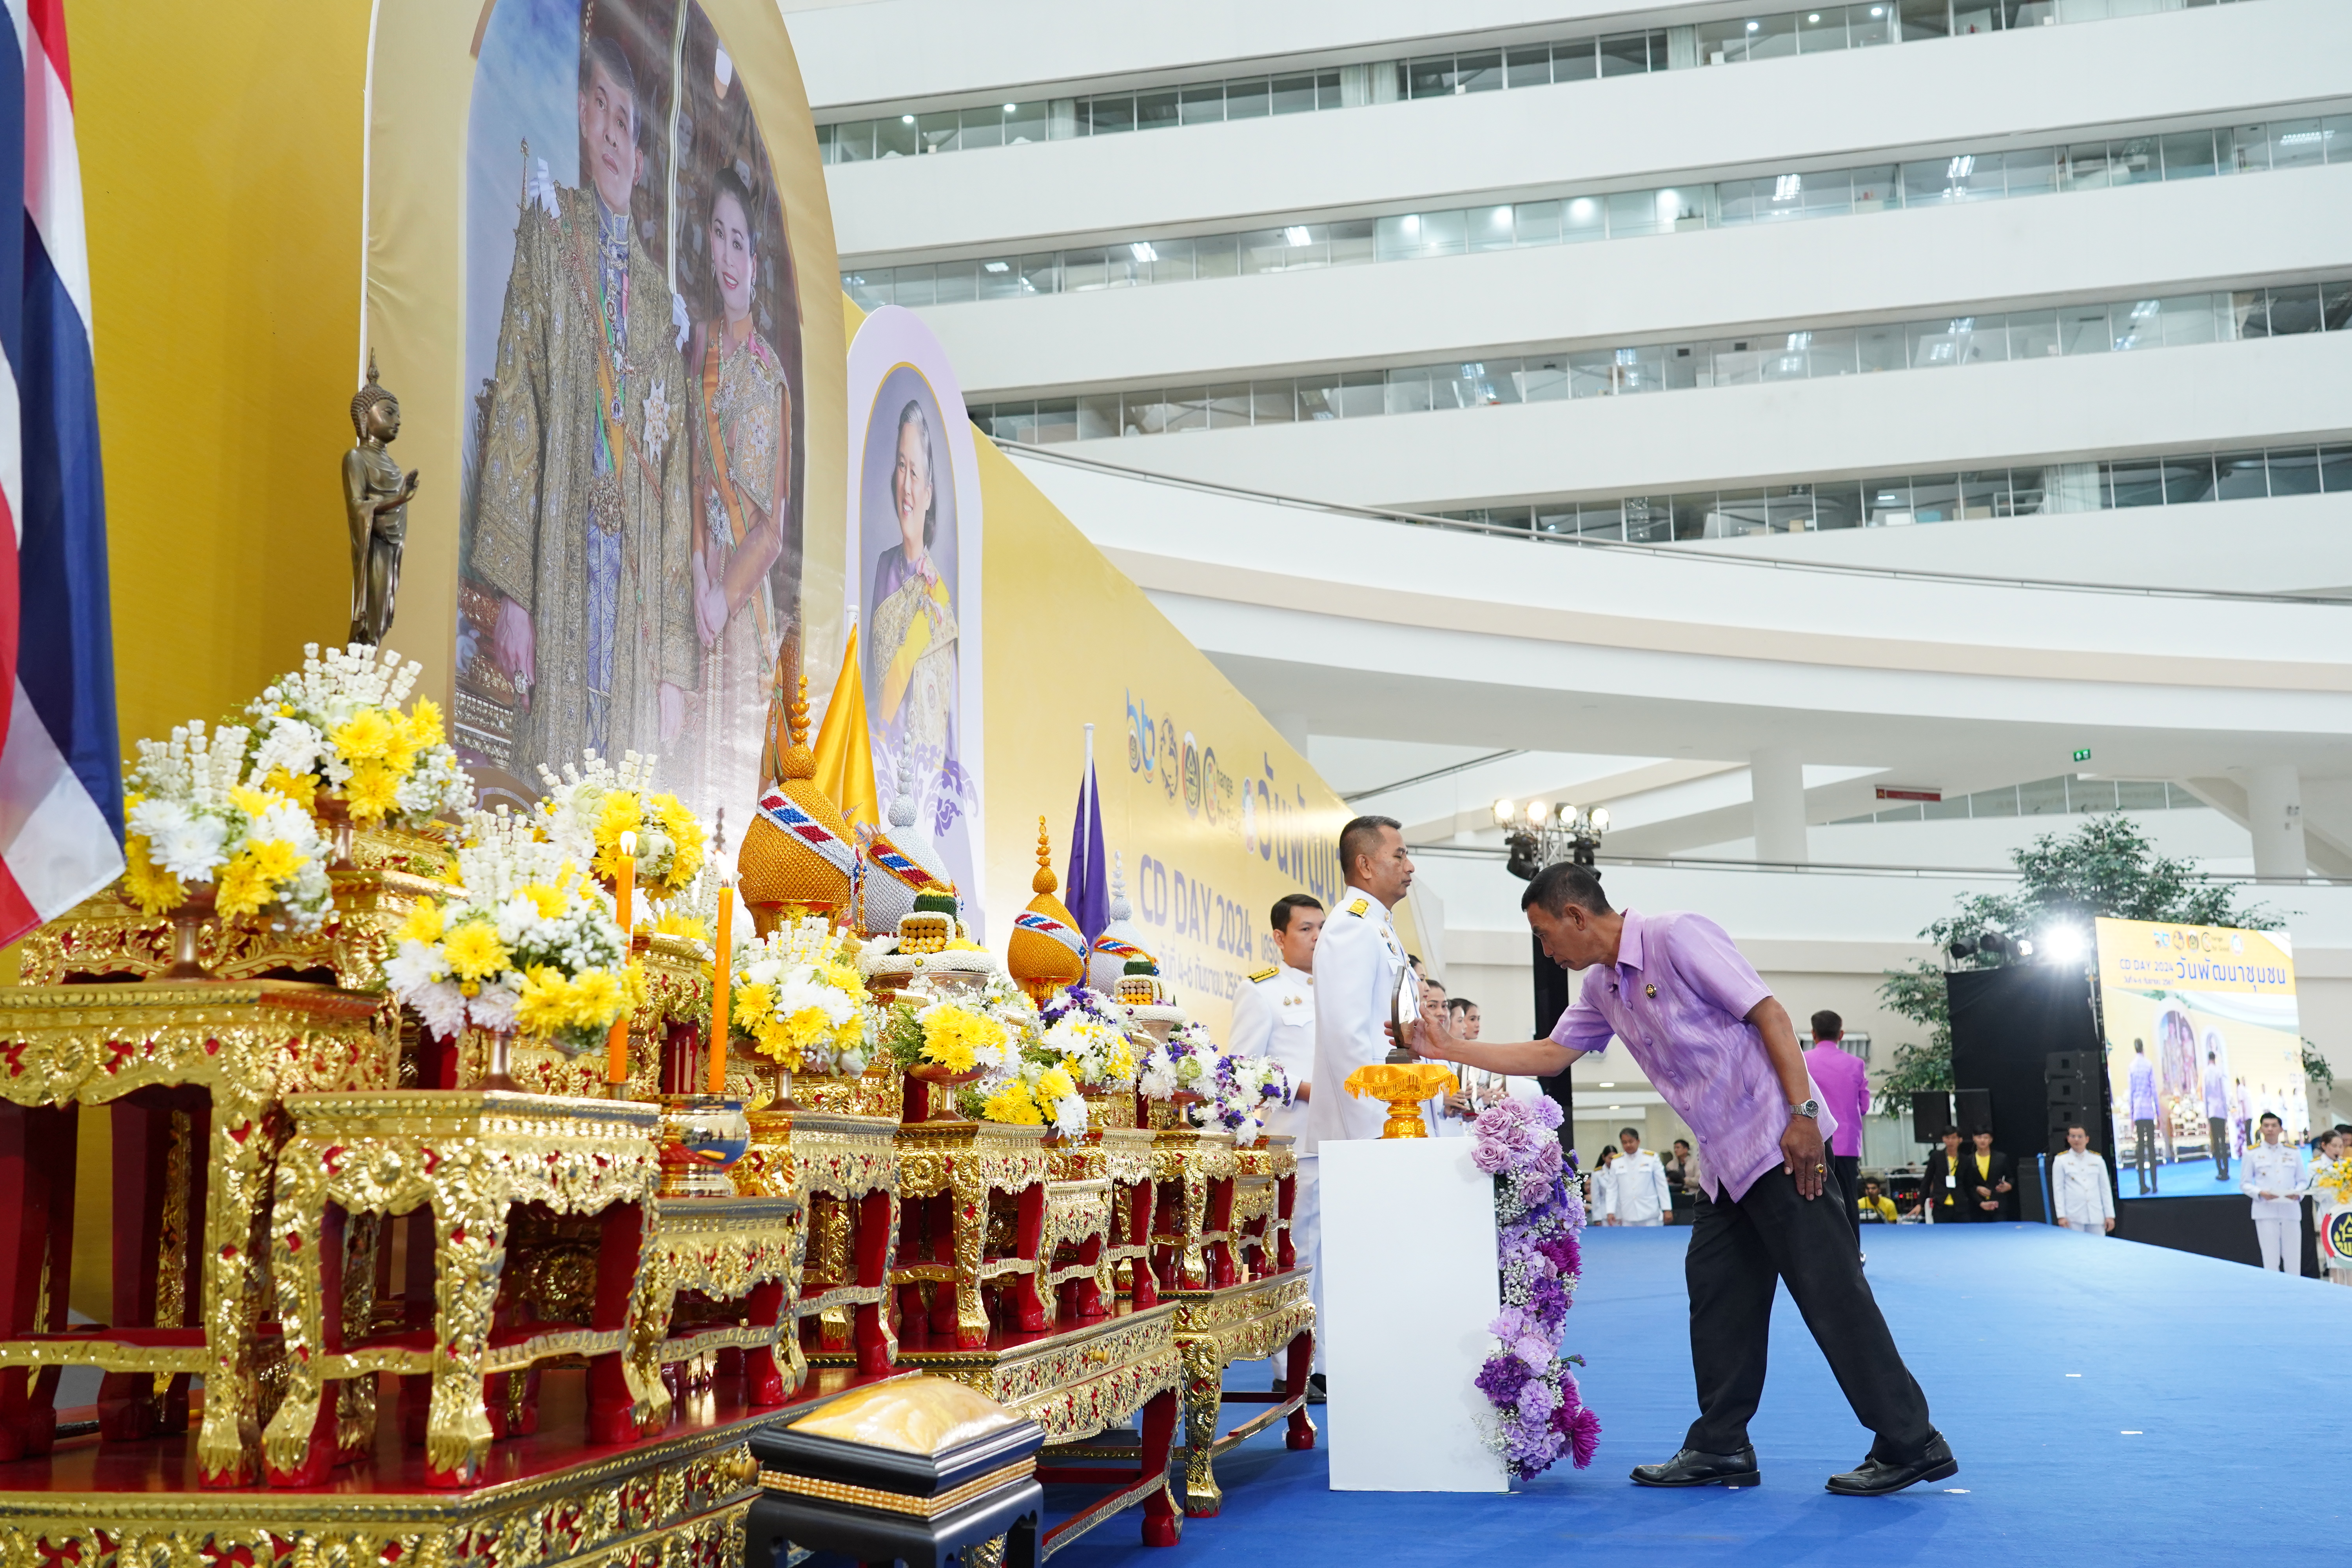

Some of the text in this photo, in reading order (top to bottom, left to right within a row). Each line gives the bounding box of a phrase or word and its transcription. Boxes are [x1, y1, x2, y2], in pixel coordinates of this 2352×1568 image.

[1140, 854, 1252, 962] CD DAY 2024
[1178, 953, 1192, 988] 4-6
[2120, 959, 2174, 972] CD DAY 2024
[2176, 956, 2286, 992] วันพัฒนาชุมชน
